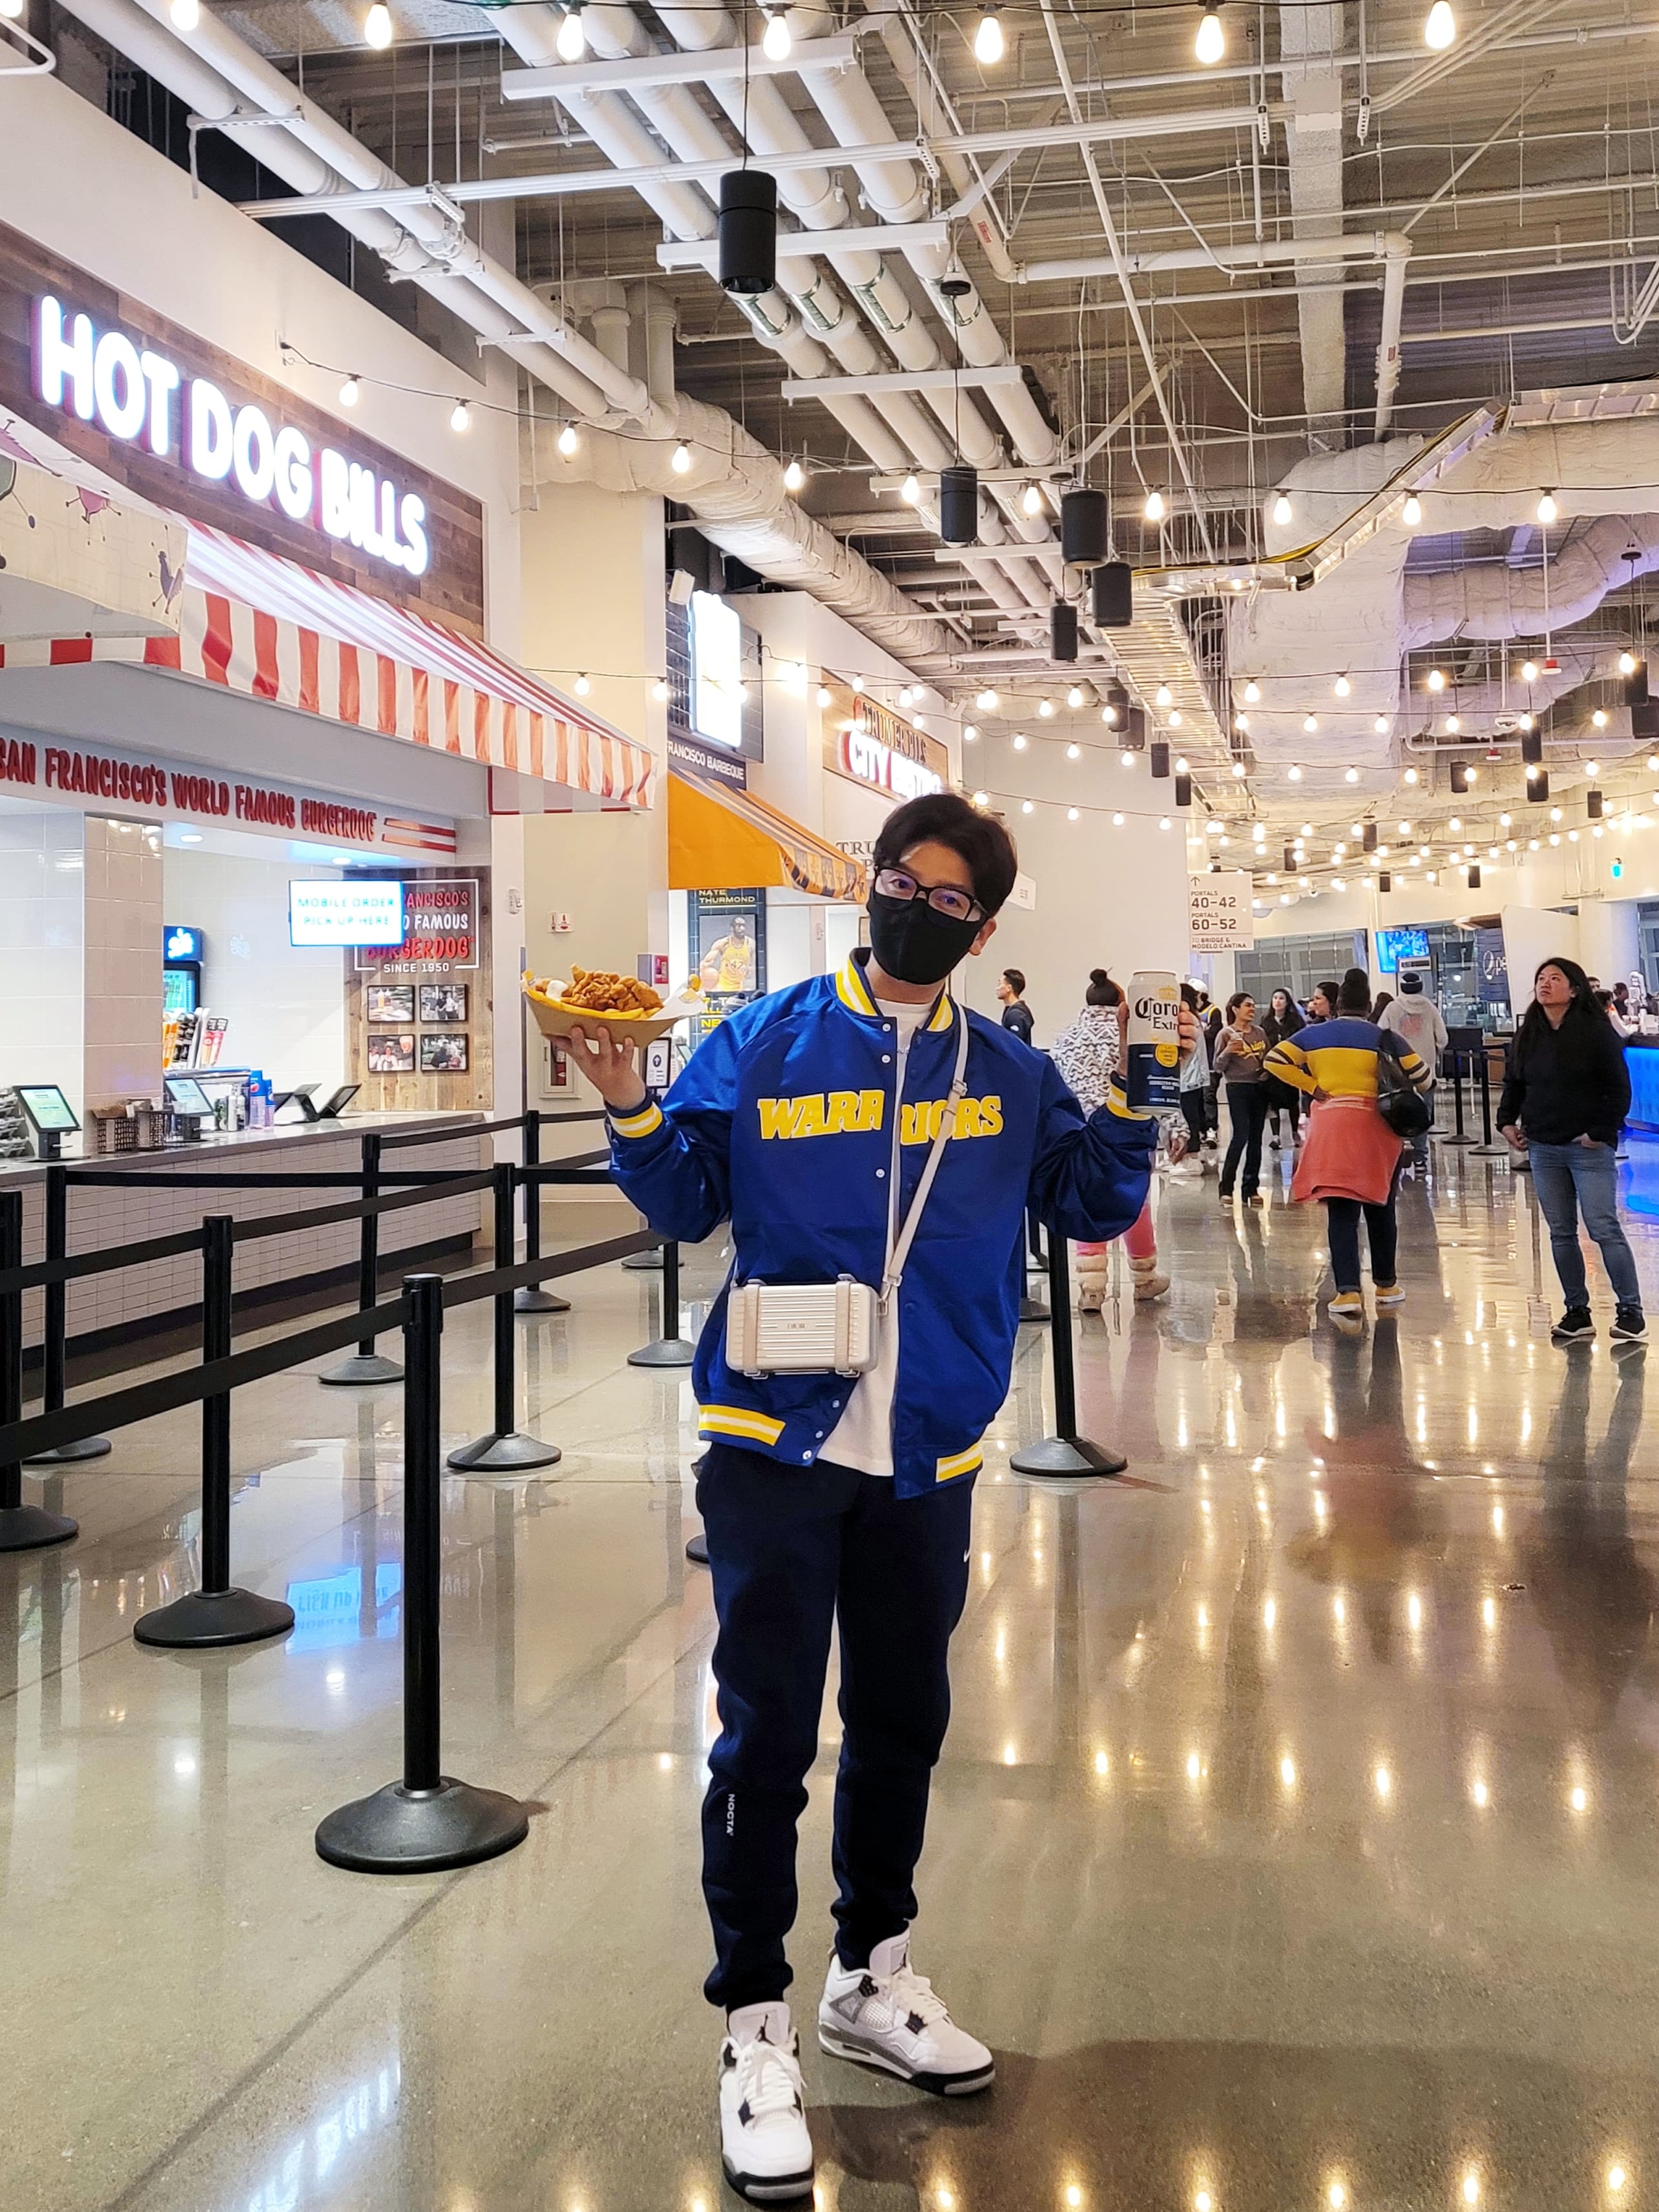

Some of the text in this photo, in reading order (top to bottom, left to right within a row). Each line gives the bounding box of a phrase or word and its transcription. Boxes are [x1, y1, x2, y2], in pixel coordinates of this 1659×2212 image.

[35, 294, 429, 576] HOT DOG BILLS
[667, 740, 744, 781] RANCISCO BARBEQUE
[845, 728, 891, 786] CITY
[45, 747, 167, 806] FRANCISCO'S
[170, 772, 229, 816] WORLD
[235, 785, 296, 829] FAMOUS
[297, 898, 395, 907] MOBILE ORDER
[404, 891, 469, 908] ANCISCO'S
[1191, 896, 1236, 908] 40-42
[304, 915, 389, 926] PICK UP HERE
[414, 913, 469, 931] FAMOUS
[1192, 918, 1236, 930] 60-52
[383, 962, 450, 974] SINCE 1950
[1134, 997, 1178, 1021] Coro
[1153, 1017, 1178, 1030] Extr
[725, 1793, 735, 1834] NOCTA
